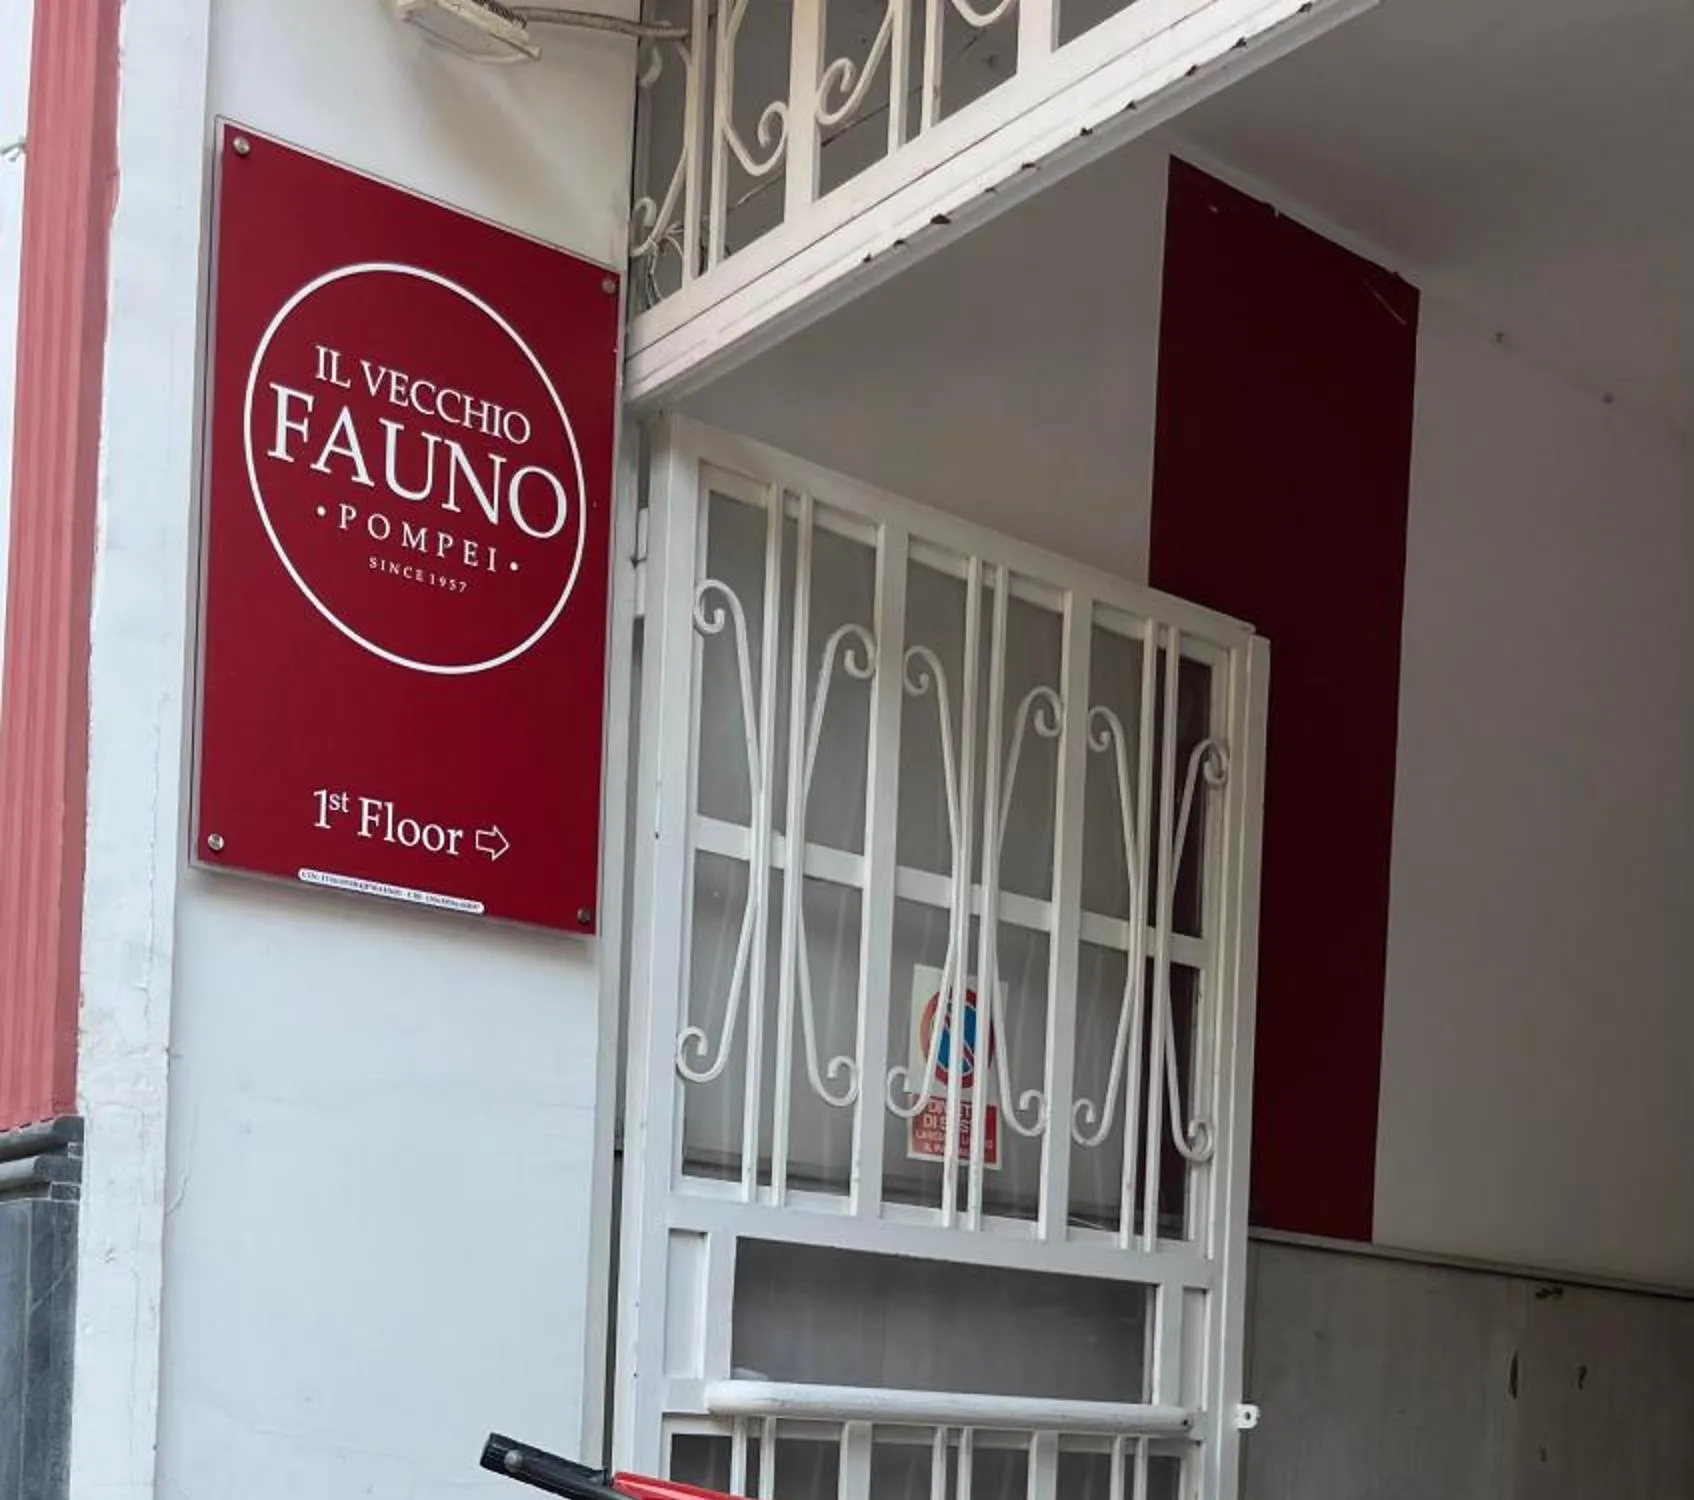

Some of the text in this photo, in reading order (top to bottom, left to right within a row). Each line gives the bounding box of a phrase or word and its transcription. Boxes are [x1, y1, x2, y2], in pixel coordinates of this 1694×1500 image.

[315, 345, 531, 445] IL VECCHIO
[267, 382, 567, 539] FAUNO
[338, 504, 498, 572] POMPEI
[369, 557, 467, 593] SINCE 1957
[313, 789, 464, 855] 1st Floor
